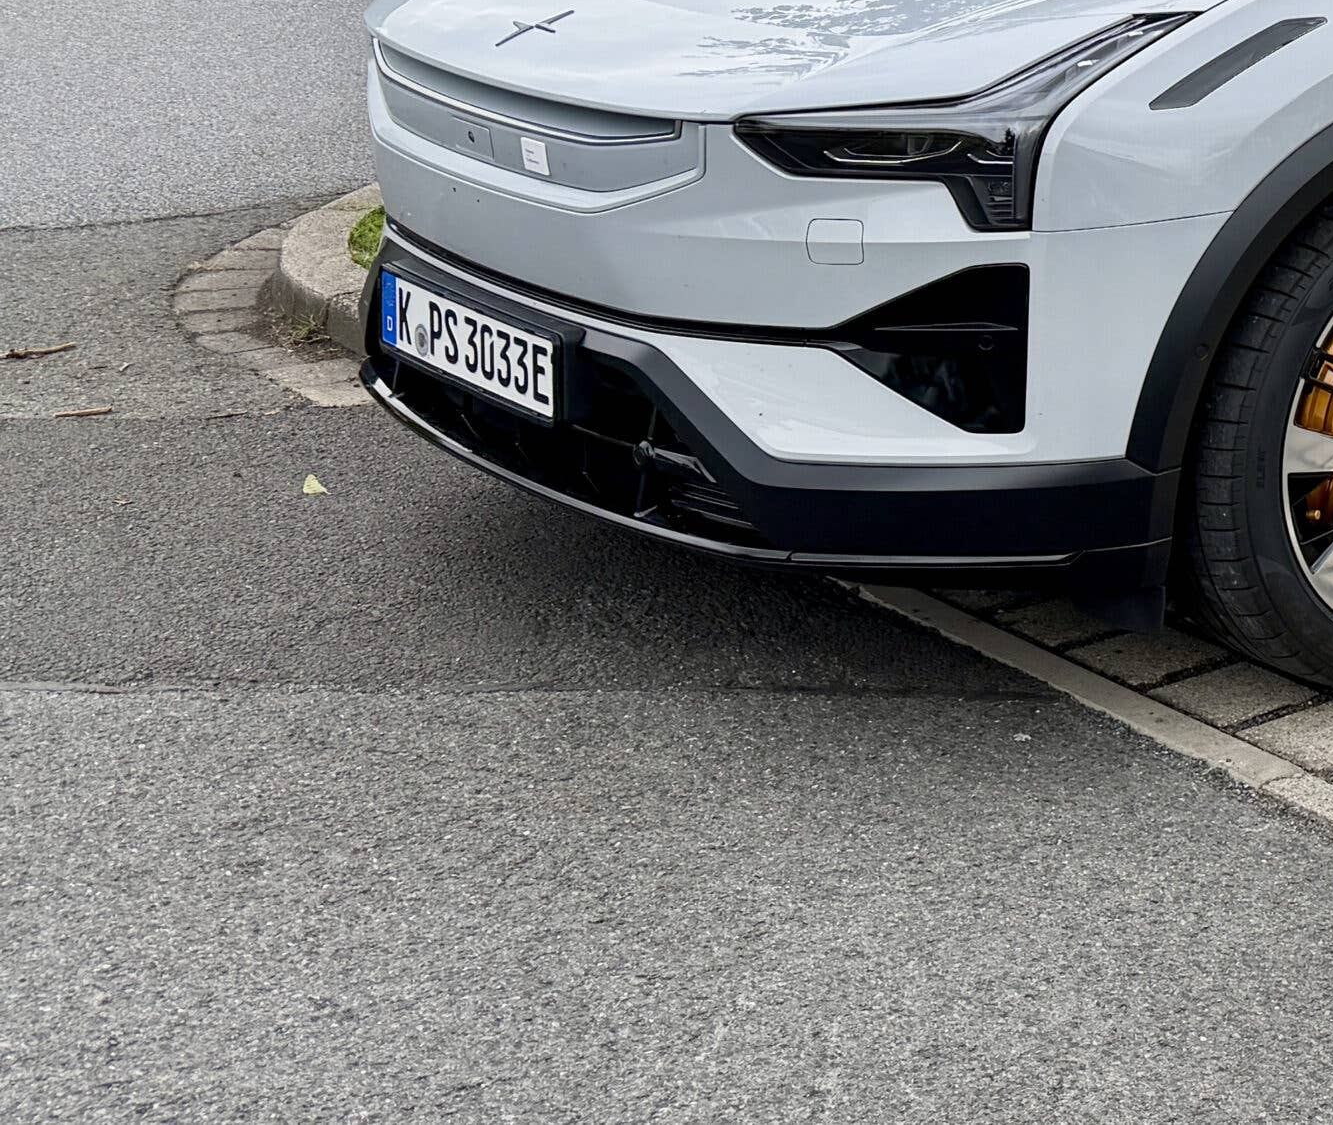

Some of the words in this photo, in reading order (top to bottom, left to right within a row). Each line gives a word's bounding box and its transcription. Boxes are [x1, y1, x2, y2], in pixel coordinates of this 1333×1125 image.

[387, 315, 393, 331] D
[398, 287, 412, 345] K
[428, 300, 459, 365] PS
[464, 316, 550, 406] 3033E
